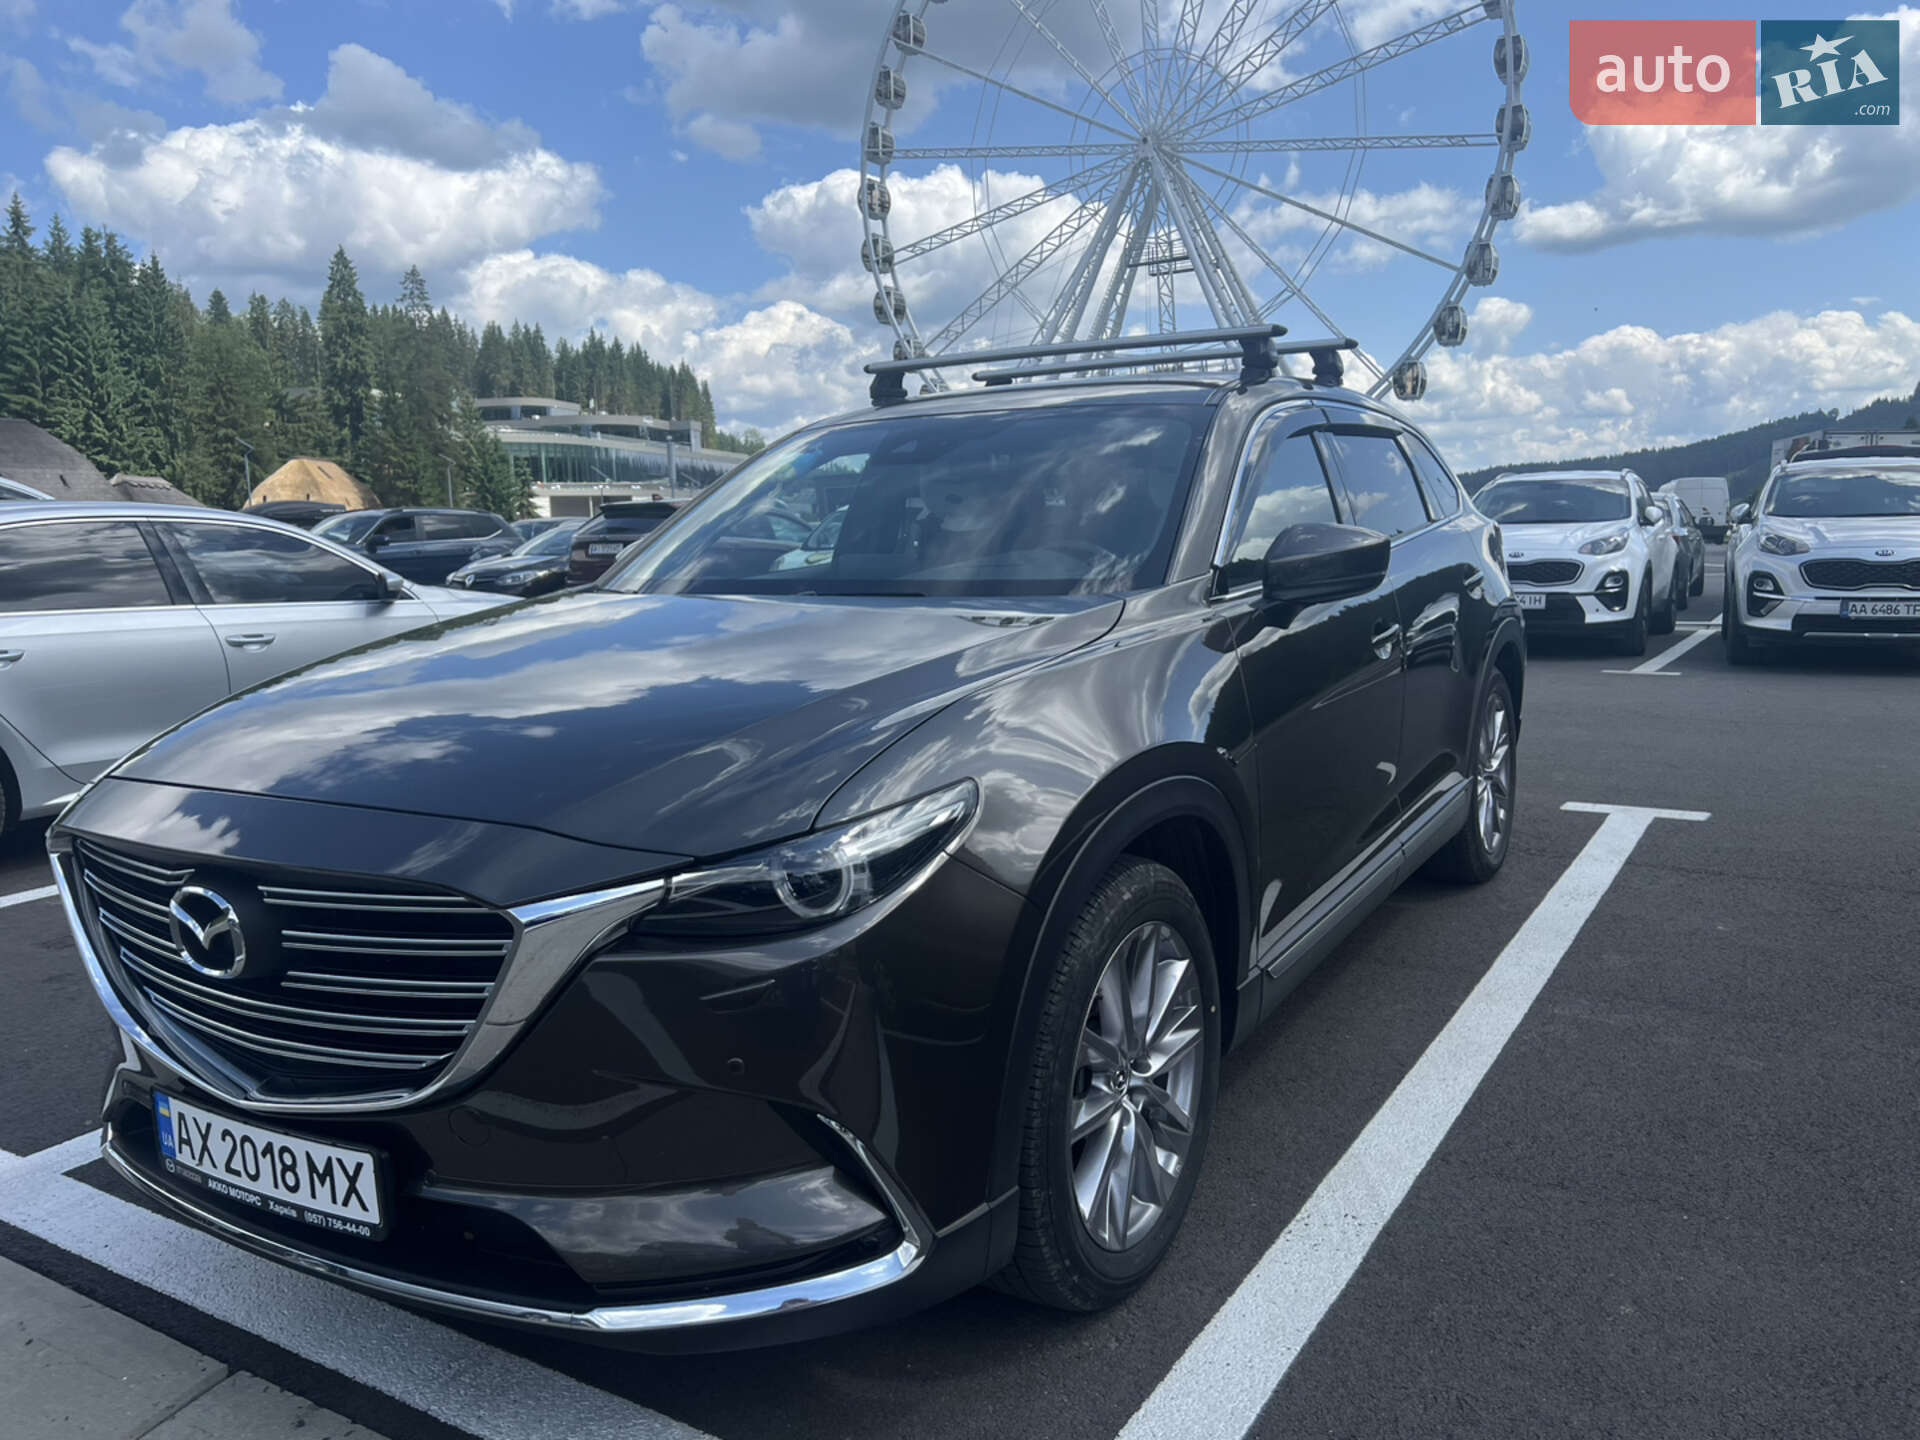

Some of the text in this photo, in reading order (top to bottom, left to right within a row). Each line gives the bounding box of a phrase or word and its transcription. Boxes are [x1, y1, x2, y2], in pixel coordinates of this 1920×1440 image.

[1849, 603, 1868, 615] AA
[1870, 603, 1901, 616] 6486
[161, 1132, 174, 1148] UA
[177, 1111, 369, 1212] AX 2018 MX
[304, 1210, 325, 1227] (057)
